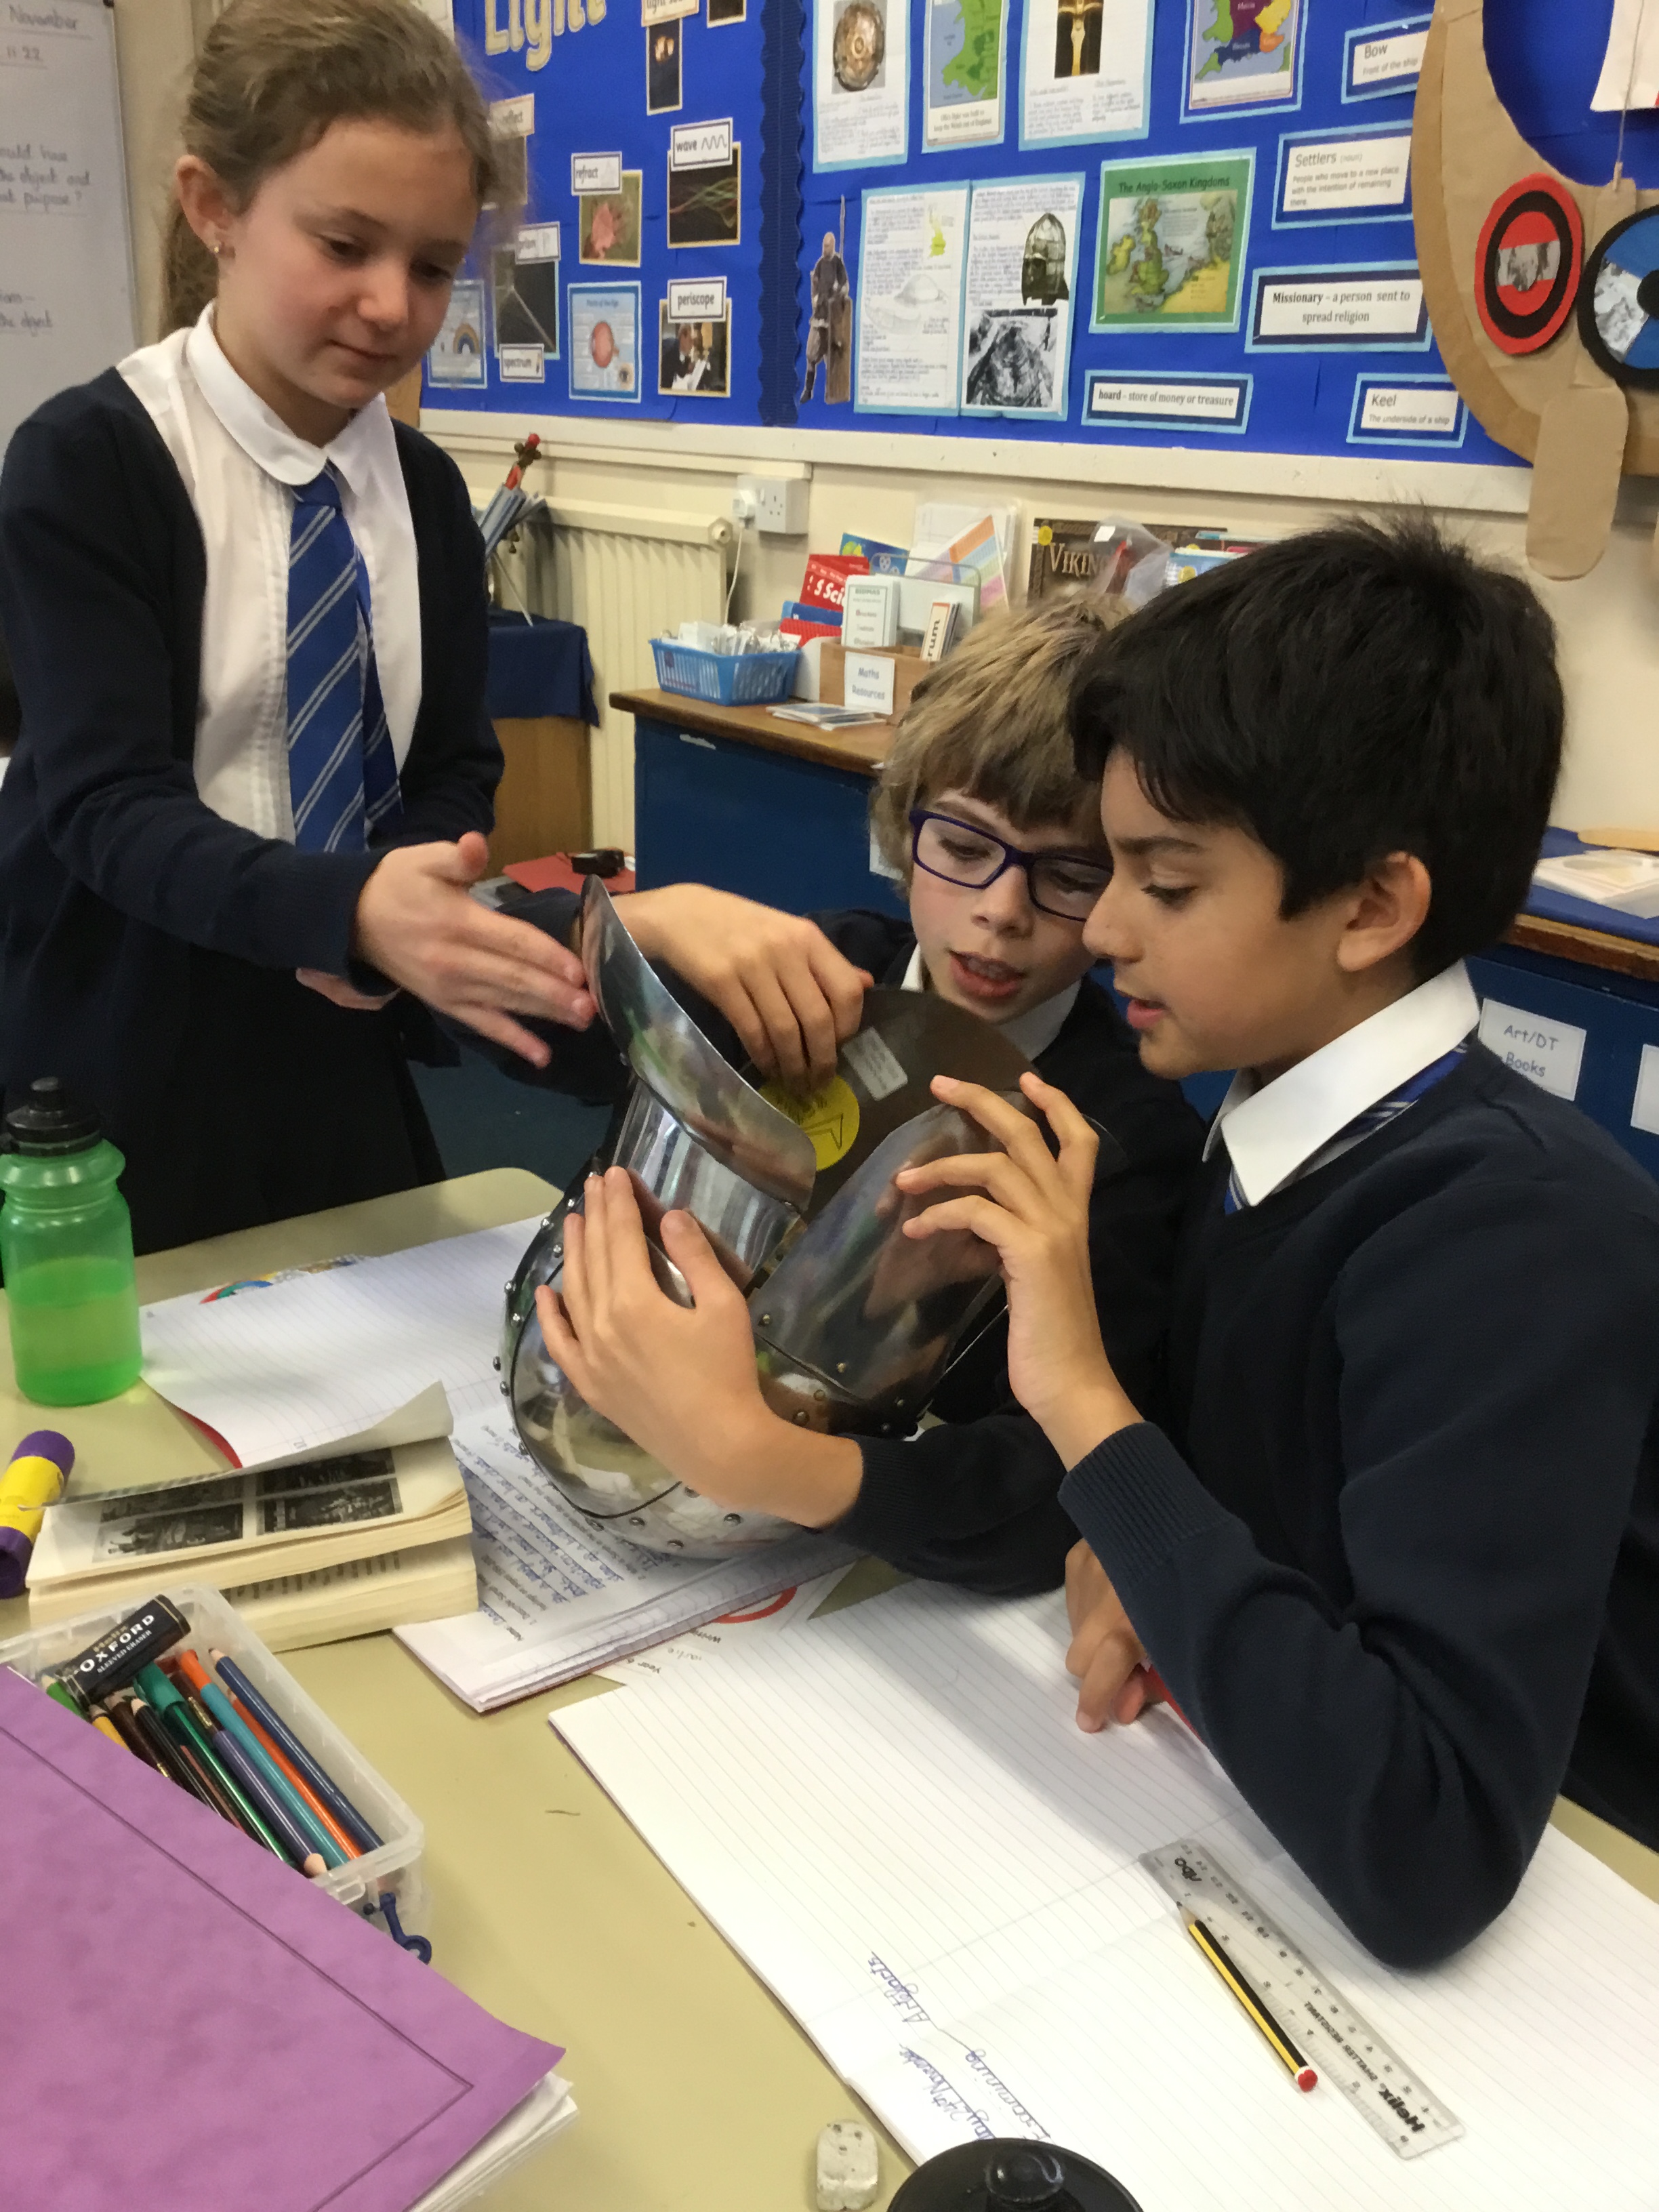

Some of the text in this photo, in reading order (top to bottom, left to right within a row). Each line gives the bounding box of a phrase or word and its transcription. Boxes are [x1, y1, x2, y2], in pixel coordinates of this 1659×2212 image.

[1364, 43, 1389, 60] Bow
[1381, 62, 1389, 72] of
[1390, 60, 1401, 69] the
[1402, 58, 1418, 68] ship
[675, 140, 697, 151] wave
[1294, 151, 1363, 169] Settlers (noun)
[575, 166, 598, 184] refract
[1292, 173, 1313, 184] People
[1315, 172, 1329, 181] who
[1330, 171, 1349, 180] move
[1350, 169, 1357, 178] to
[1380, 165, 1399, 177] place
[1119, 176, 1230, 194] The Anglo-Saxon Kingdoms
[1291, 178, 1391, 195] with the intention of remaining
[677, 293, 715, 310] periscope
[1272, 291, 1324, 306] Missionary
[1332, 295, 1338, 303] a
[1339, 291, 1372, 305] person
[1376, 291, 1397, 302] sent
[1400, 290, 1410, 302] to
[1302, 310, 1370, 325] spread religion
[1099, 389, 1122, 401] hoard
[1128, 391, 1148, 401] store
[1149, 391, 1158, 402] of
[1158, 394, 1185, 405] money
[1187, 395, 1196, 404] or
[1197, 394, 1233, 407] treasure
[1371, 393, 1397, 407] Keel
[1368, 413, 1381, 423] The
[1382, 414, 1417, 424] underside
[1418, 414, 1427, 424] of
[1434, 416, 1450, 426] ship
[858, 667, 880, 680] Maths
[852, 684, 885, 701] Resources
[1503, 1025, 1559, 1051] Art/DT
[1504, 1051, 1546, 1078] Books
[79, 1614, 155, 1673] OXFORD
[97, 1629, 152, 1673] SLEEVED ERASER
